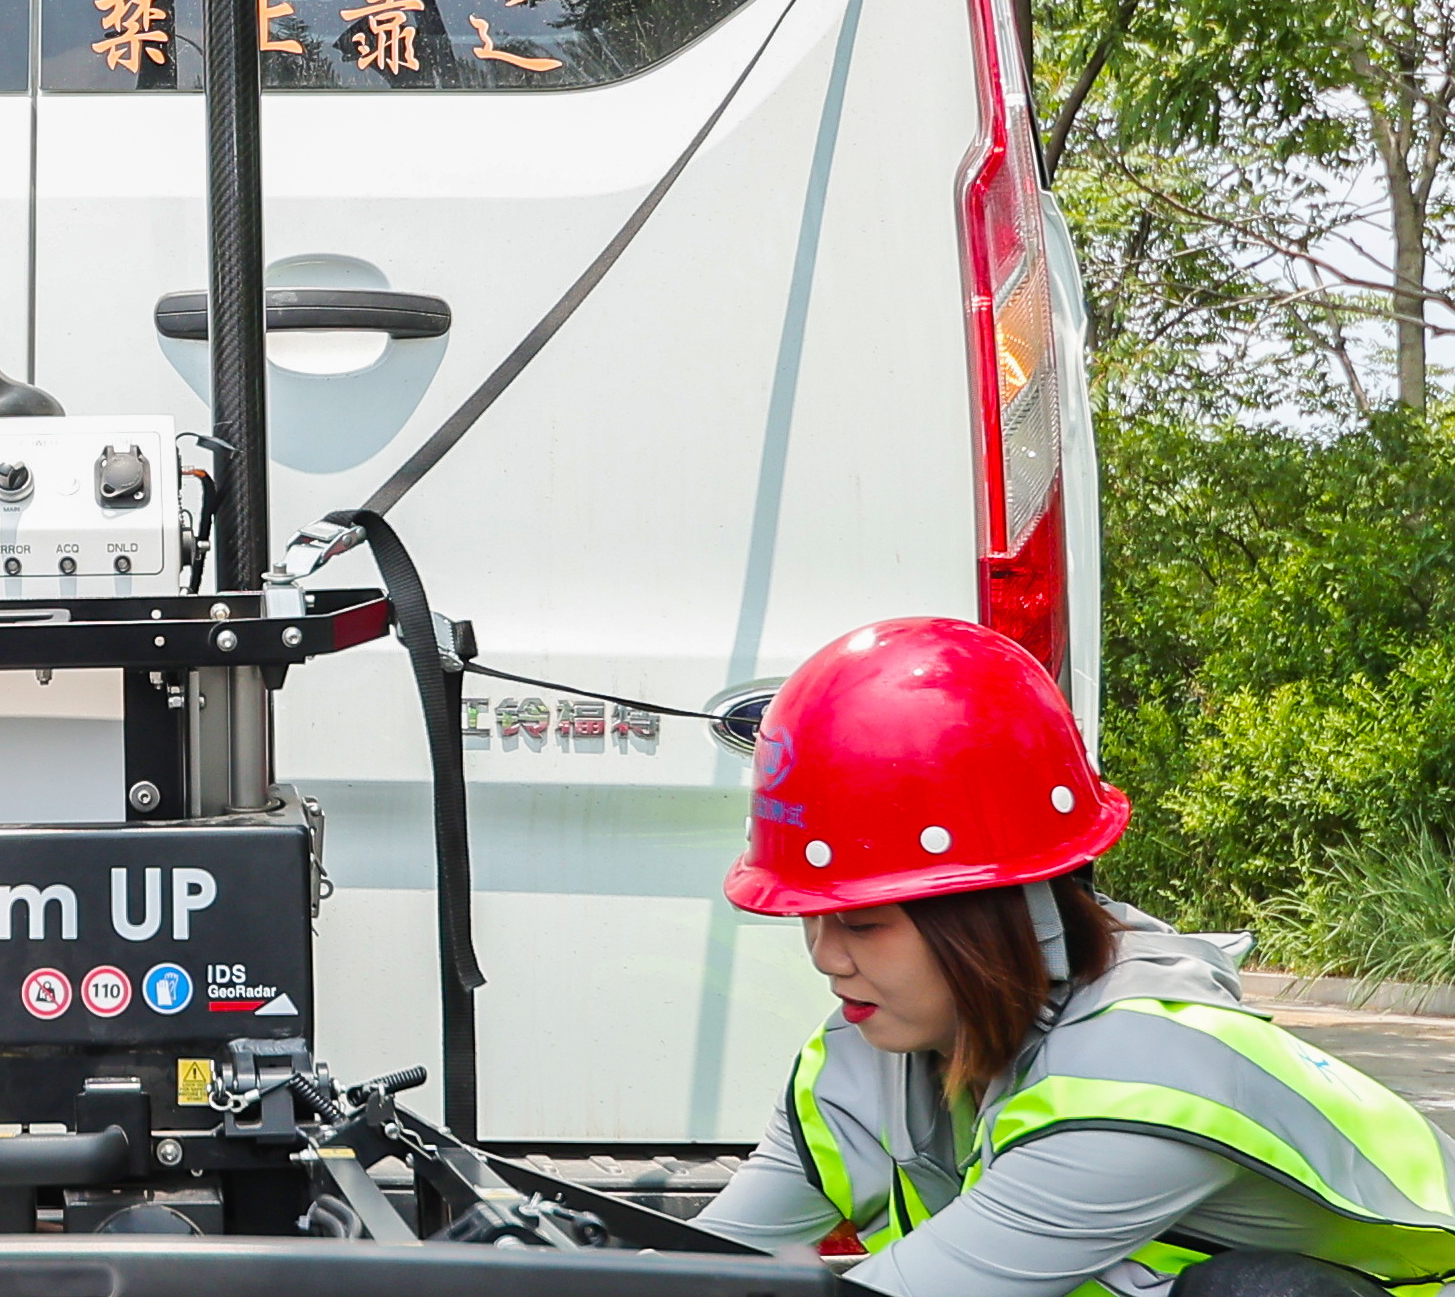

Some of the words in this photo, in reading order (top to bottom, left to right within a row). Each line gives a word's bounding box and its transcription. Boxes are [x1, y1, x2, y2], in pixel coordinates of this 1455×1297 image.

[56, 544, 80, 554] ACQ
[107, 543, 138, 553] DNLD
[110, 867, 217, 942] UP
[207, 964, 246, 984] IDS
[91, 982, 121, 999] 110
[207, 984, 277, 999] GeoRadar
